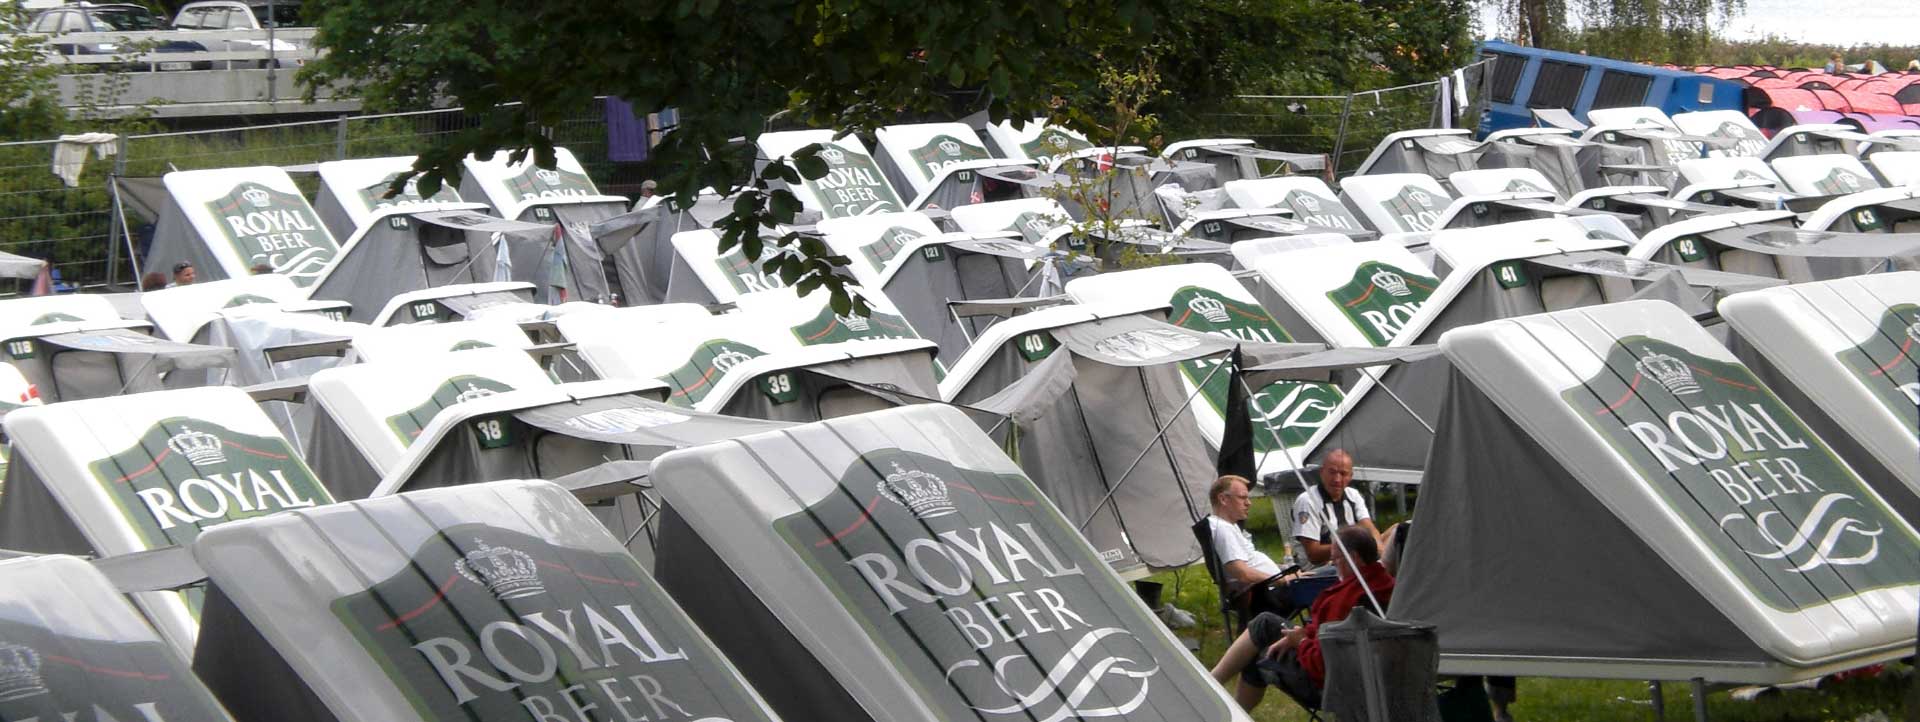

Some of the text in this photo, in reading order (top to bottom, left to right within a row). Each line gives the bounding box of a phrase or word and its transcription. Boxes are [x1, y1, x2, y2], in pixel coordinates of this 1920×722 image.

[836, 188, 880, 203] BEER
[225, 209, 316, 237] ROYAL
[1858, 210, 1876, 225] 43
[256, 232, 312, 252] BEER
[1679, 240, 1697, 256] 42
[1501, 265, 1517, 282] 41
[414, 302, 436, 318] 120
[1024, 335, 1044, 352] 40
[767, 373, 791, 394] 39
[1624, 400, 1809, 473] ROYAL
[1708, 457, 1825, 506] BEER
[136, 468, 316, 529] ROYAL
[846, 521, 1085, 616] ROYAL
[944, 588, 1094, 651] BEER
[411, 602, 689, 705] ROYAL
[520, 674, 693, 722] BEER
